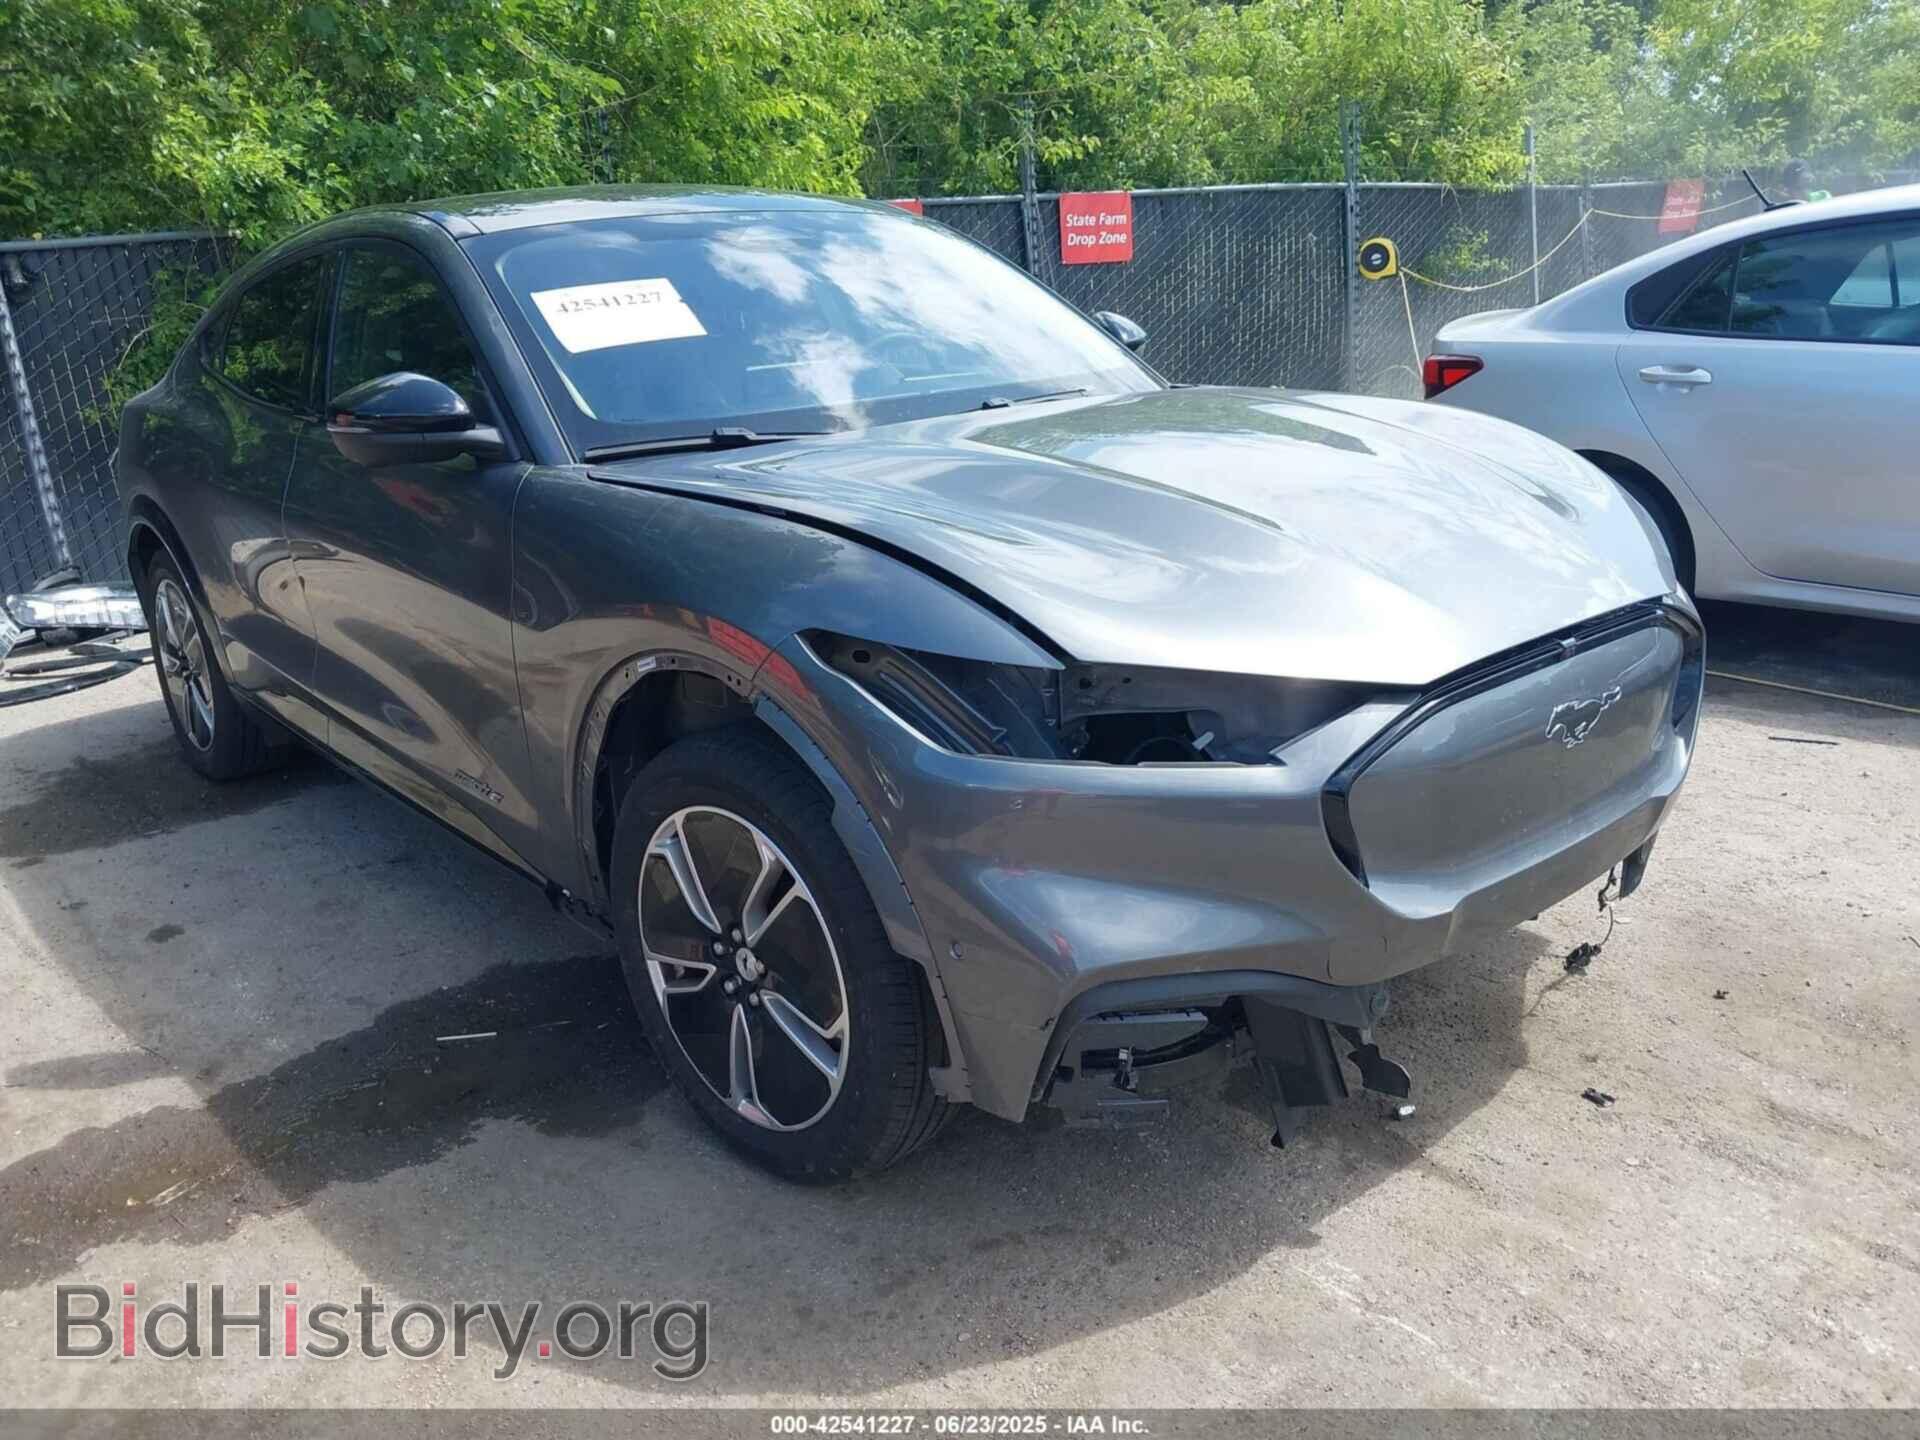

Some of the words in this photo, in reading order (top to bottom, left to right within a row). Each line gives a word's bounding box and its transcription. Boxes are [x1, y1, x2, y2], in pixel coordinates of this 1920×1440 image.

[1066, 213, 1096, 227] State
[1098, 212, 1127, 225] Farm
[1067, 232, 1097, 248] Drop
[1098, 231, 1127, 244] Zone
[555, 290, 663, 314] 42541227
